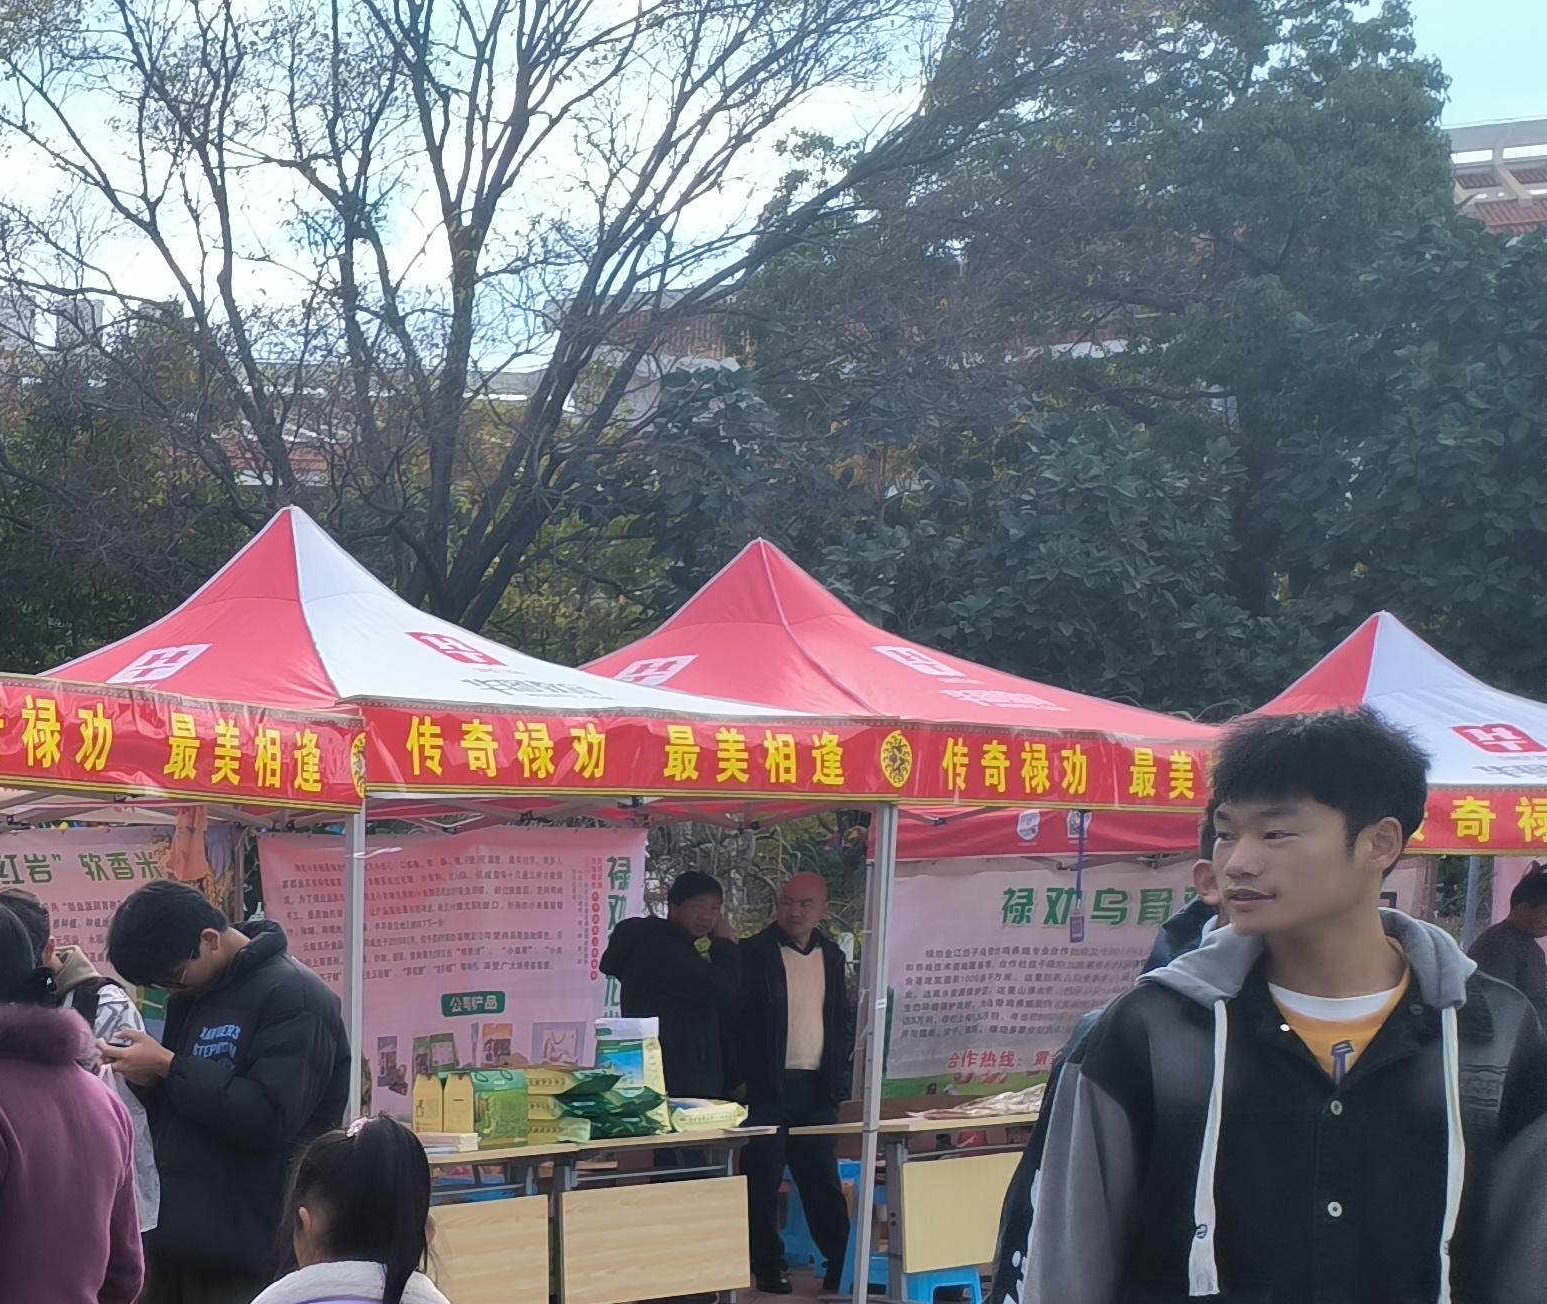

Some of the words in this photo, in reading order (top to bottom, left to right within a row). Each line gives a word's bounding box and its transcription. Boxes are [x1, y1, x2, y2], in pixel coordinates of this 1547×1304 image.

[162, 713, 324, 794] 最美相逢
[406, 714, 607, 780] 传奇禄劝
[663, 724, 845, 787] 最美相逢
[942, 736, 1088, 795] 传奇禄劝
[1411, 795, 1547, 844] 奇禄
[1001, 886, 1200, 926] 禄劝乌骨
